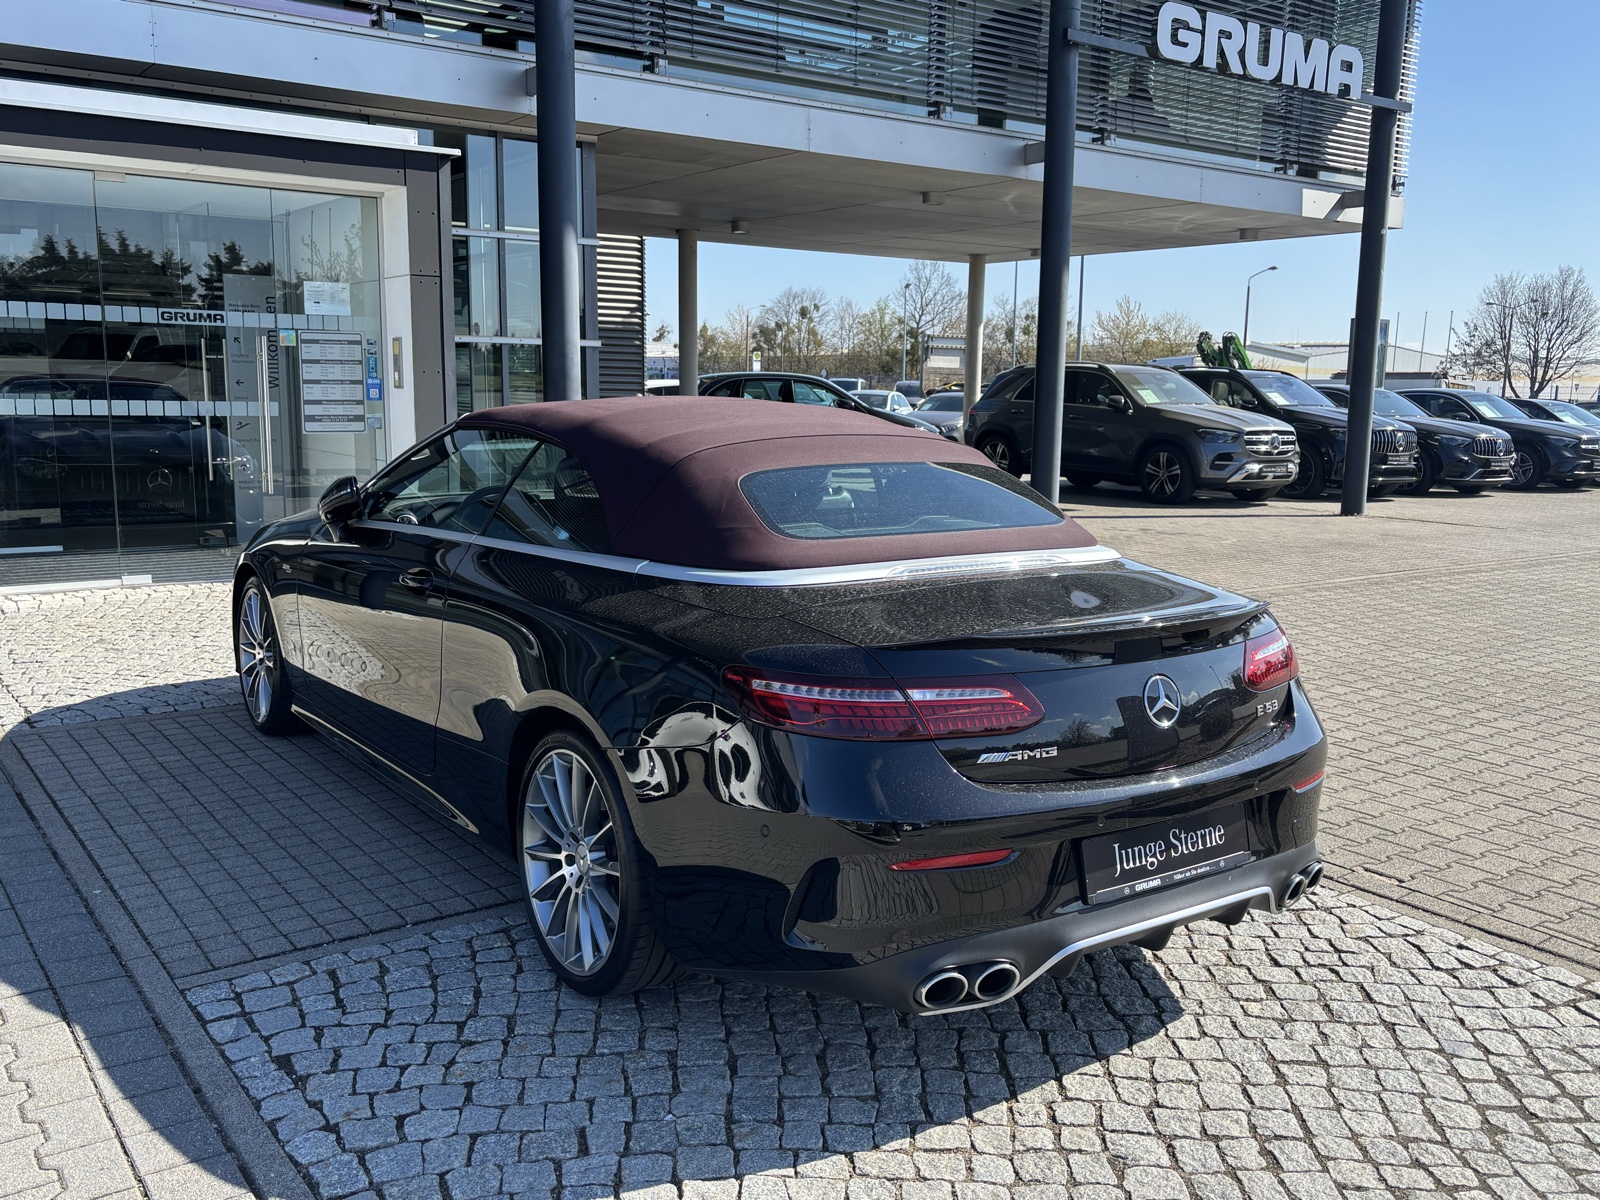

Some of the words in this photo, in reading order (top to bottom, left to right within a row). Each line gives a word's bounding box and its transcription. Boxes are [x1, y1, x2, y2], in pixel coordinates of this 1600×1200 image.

[1156, 1, 1364, 100] GRUMA
[160, 311, 225, 324] GRUMA
[265, 296, 280, 389] Willkomen
[1256, 704, 1264, 717] E
[1264, 699, 1278, 713] 53
[1003, 746, 1058, 762] AMG
[1112, 839, 1166, 877] Junge
[1169, 824, 1225, 857] Sterne
[1135, 878, 1161, 892] GRUMA
